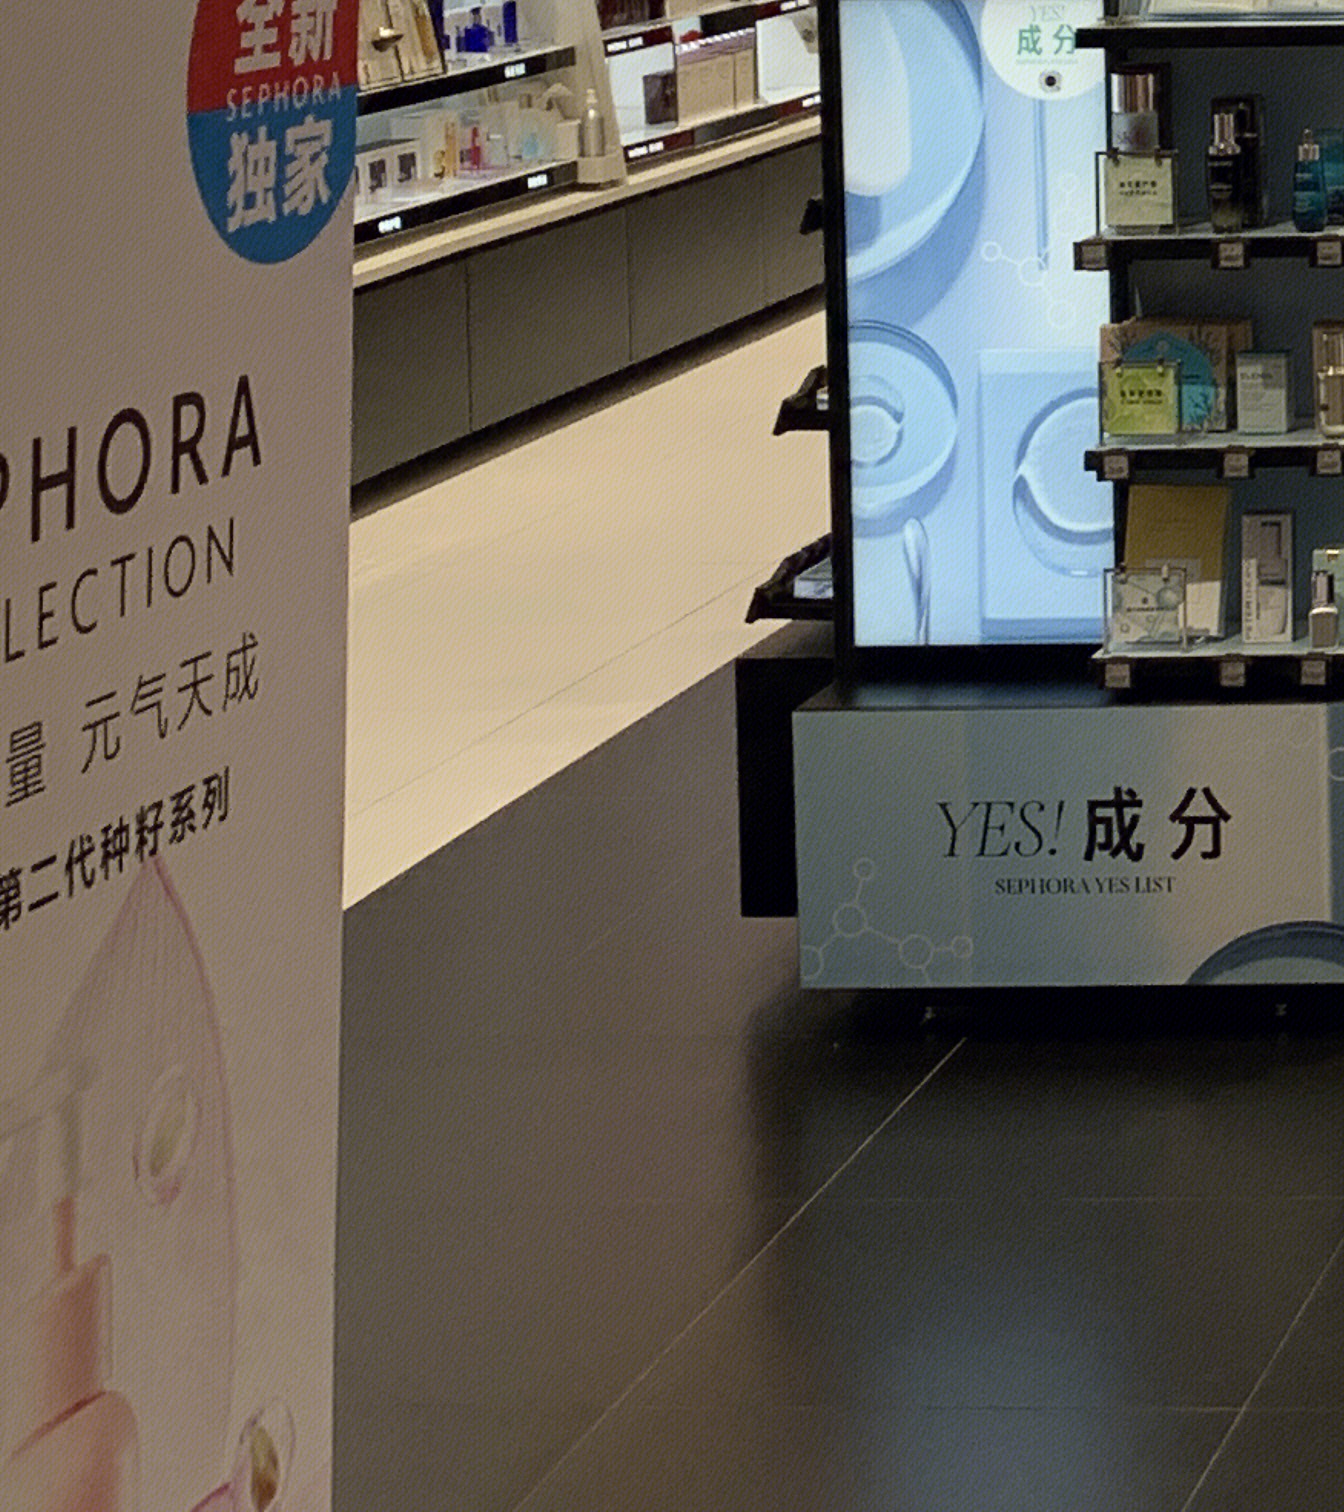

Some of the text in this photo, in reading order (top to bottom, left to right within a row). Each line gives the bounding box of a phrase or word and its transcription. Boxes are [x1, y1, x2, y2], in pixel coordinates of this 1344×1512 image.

[1016, 24, 1077, 56] 成分
[226, 70, 343, 123] SEPHORA
[226, 114, 334, 235] 独家
[3, 517, 235, 663] LECTION
[4, 631, 260, 808] 量 元气天成
[935, 785, 1233, 863] YES! 成分
[994, 874, 1177, 895] SEPHORA YES LIST
